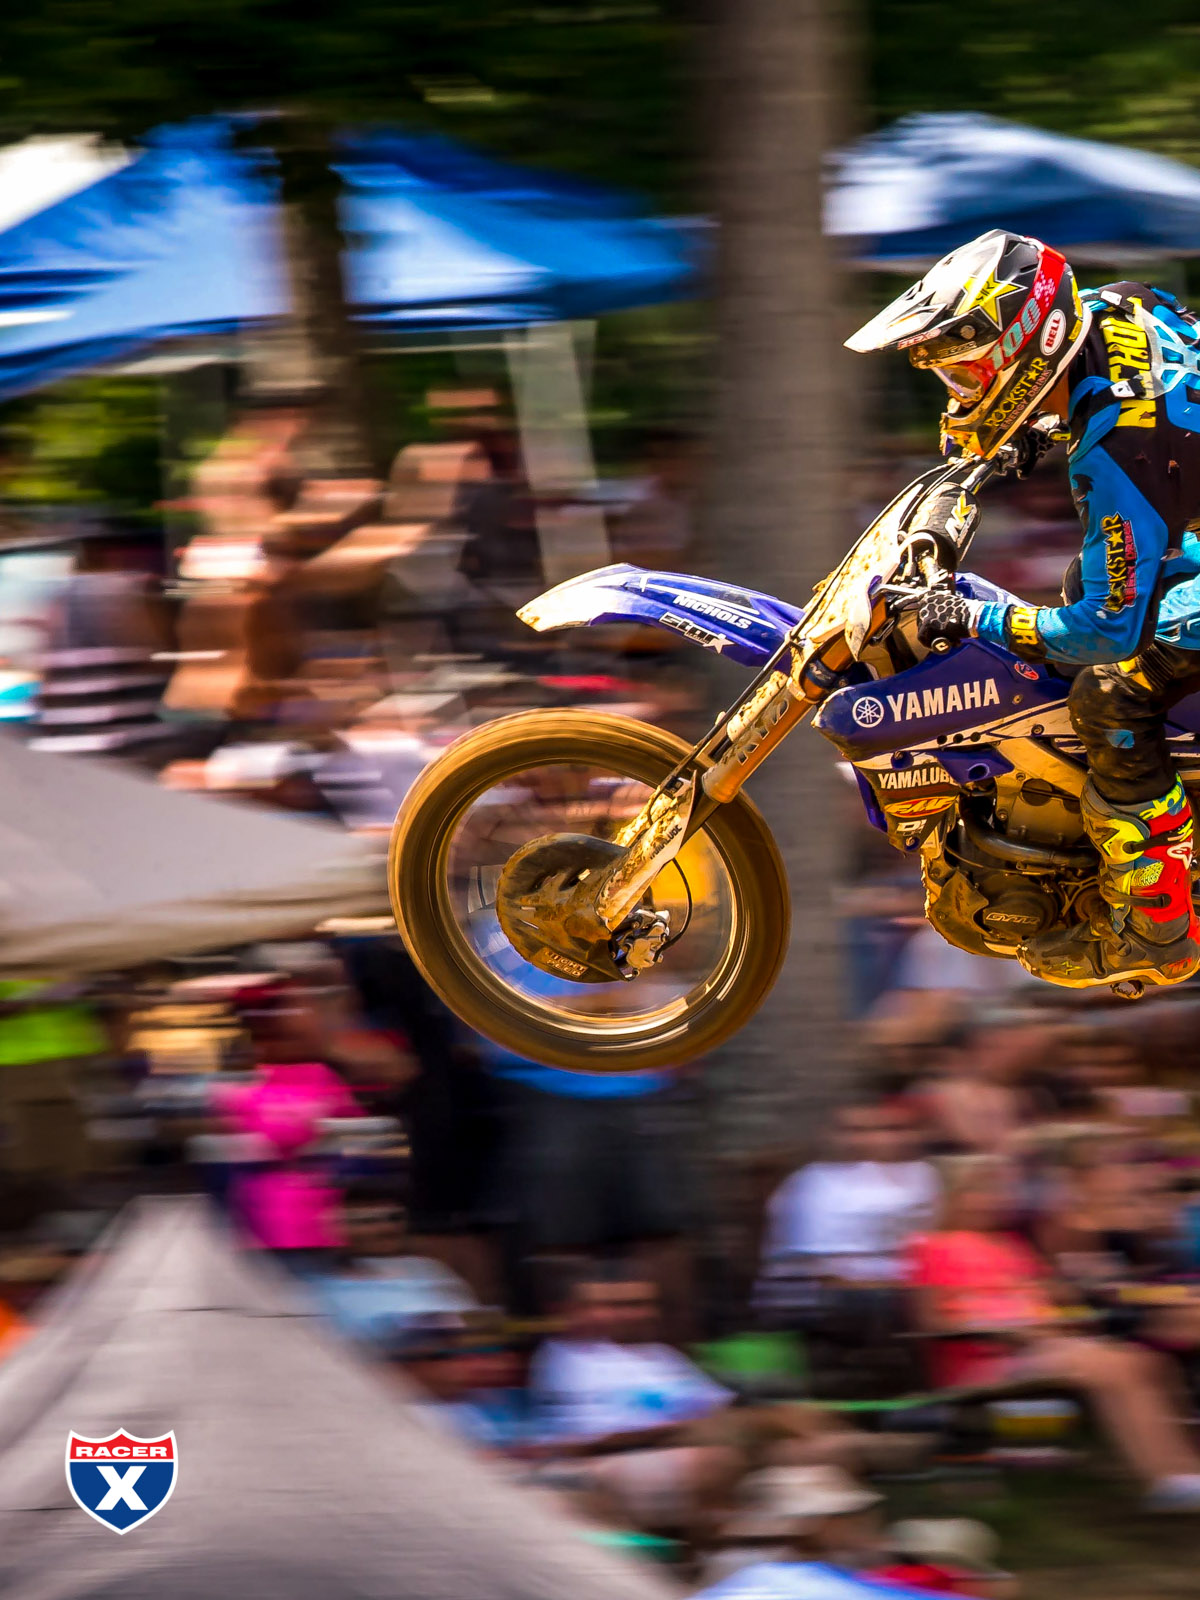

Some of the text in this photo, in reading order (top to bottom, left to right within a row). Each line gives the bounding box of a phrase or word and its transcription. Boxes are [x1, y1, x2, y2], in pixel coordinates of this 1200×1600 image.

[1046, 318, 1061, 349] BELL
[673, 595, 752, 630] NICHOLS
[886, 678, 1000, 722] YAMAHA
[885, 796, 956, 815] FMF
